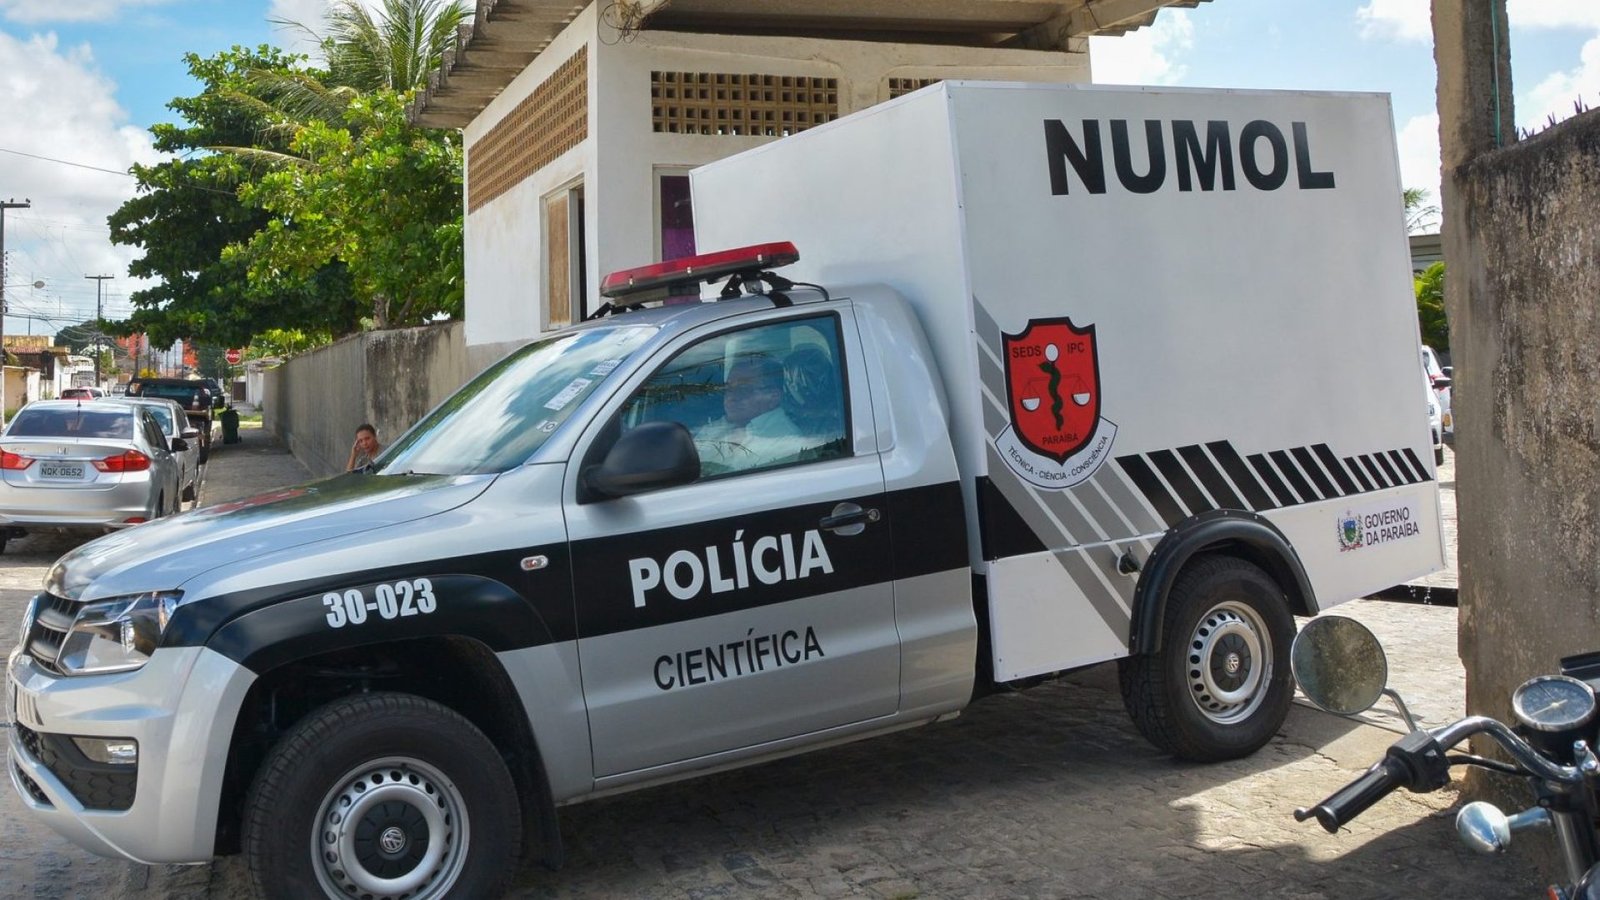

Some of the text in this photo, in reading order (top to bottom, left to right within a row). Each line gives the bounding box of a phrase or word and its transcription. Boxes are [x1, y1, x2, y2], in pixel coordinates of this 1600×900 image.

[1044, 118, 1336, 196] NUMOL
[1012, 342, 1085, 358] SEDS IPC
[1008, 446, 1034, 475] TÉCNICA
[1071, 436, 1108, 477] CONSCIÊNCIA
[1364, 507, 1410, 529] GOVERNO
[1366, 521, 1419, 546] DA PARAÍBA
[628, 530, 834, 608] POLÍCIA
[322, 577, 437, 629] 30-023
[653, 625, 825, 691] CIENTÍFICA
